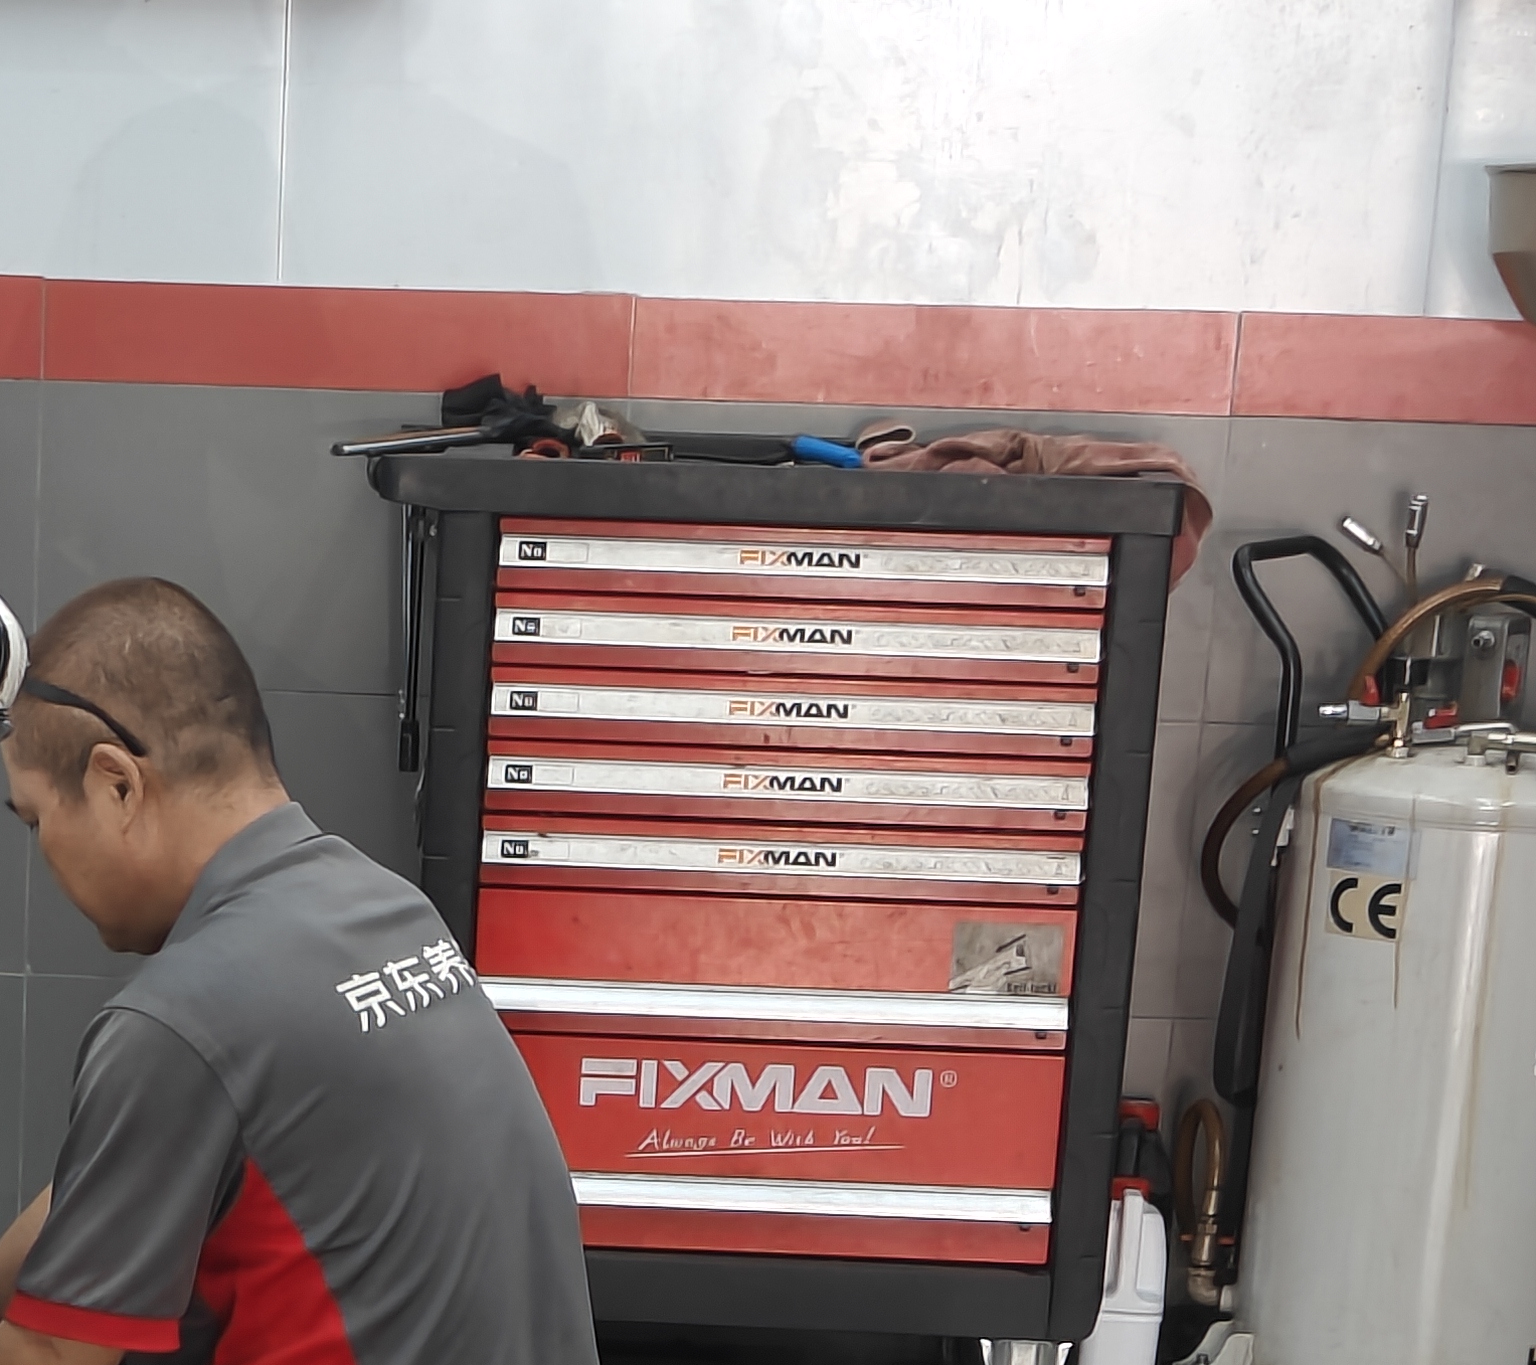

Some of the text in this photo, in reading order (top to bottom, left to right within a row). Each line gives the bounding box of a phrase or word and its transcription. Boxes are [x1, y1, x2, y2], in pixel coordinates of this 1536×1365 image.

[739, 550, 861, 570] FIXMAN
[732, 625, 852, 645] FIXMAN
[728, 700, 849, 720] FIXMAN
[723, 773, 843, 793] FIXMAN
[717, 848, 837, 868] FIXMAN
[1330, 877, 1403, 939] CE
